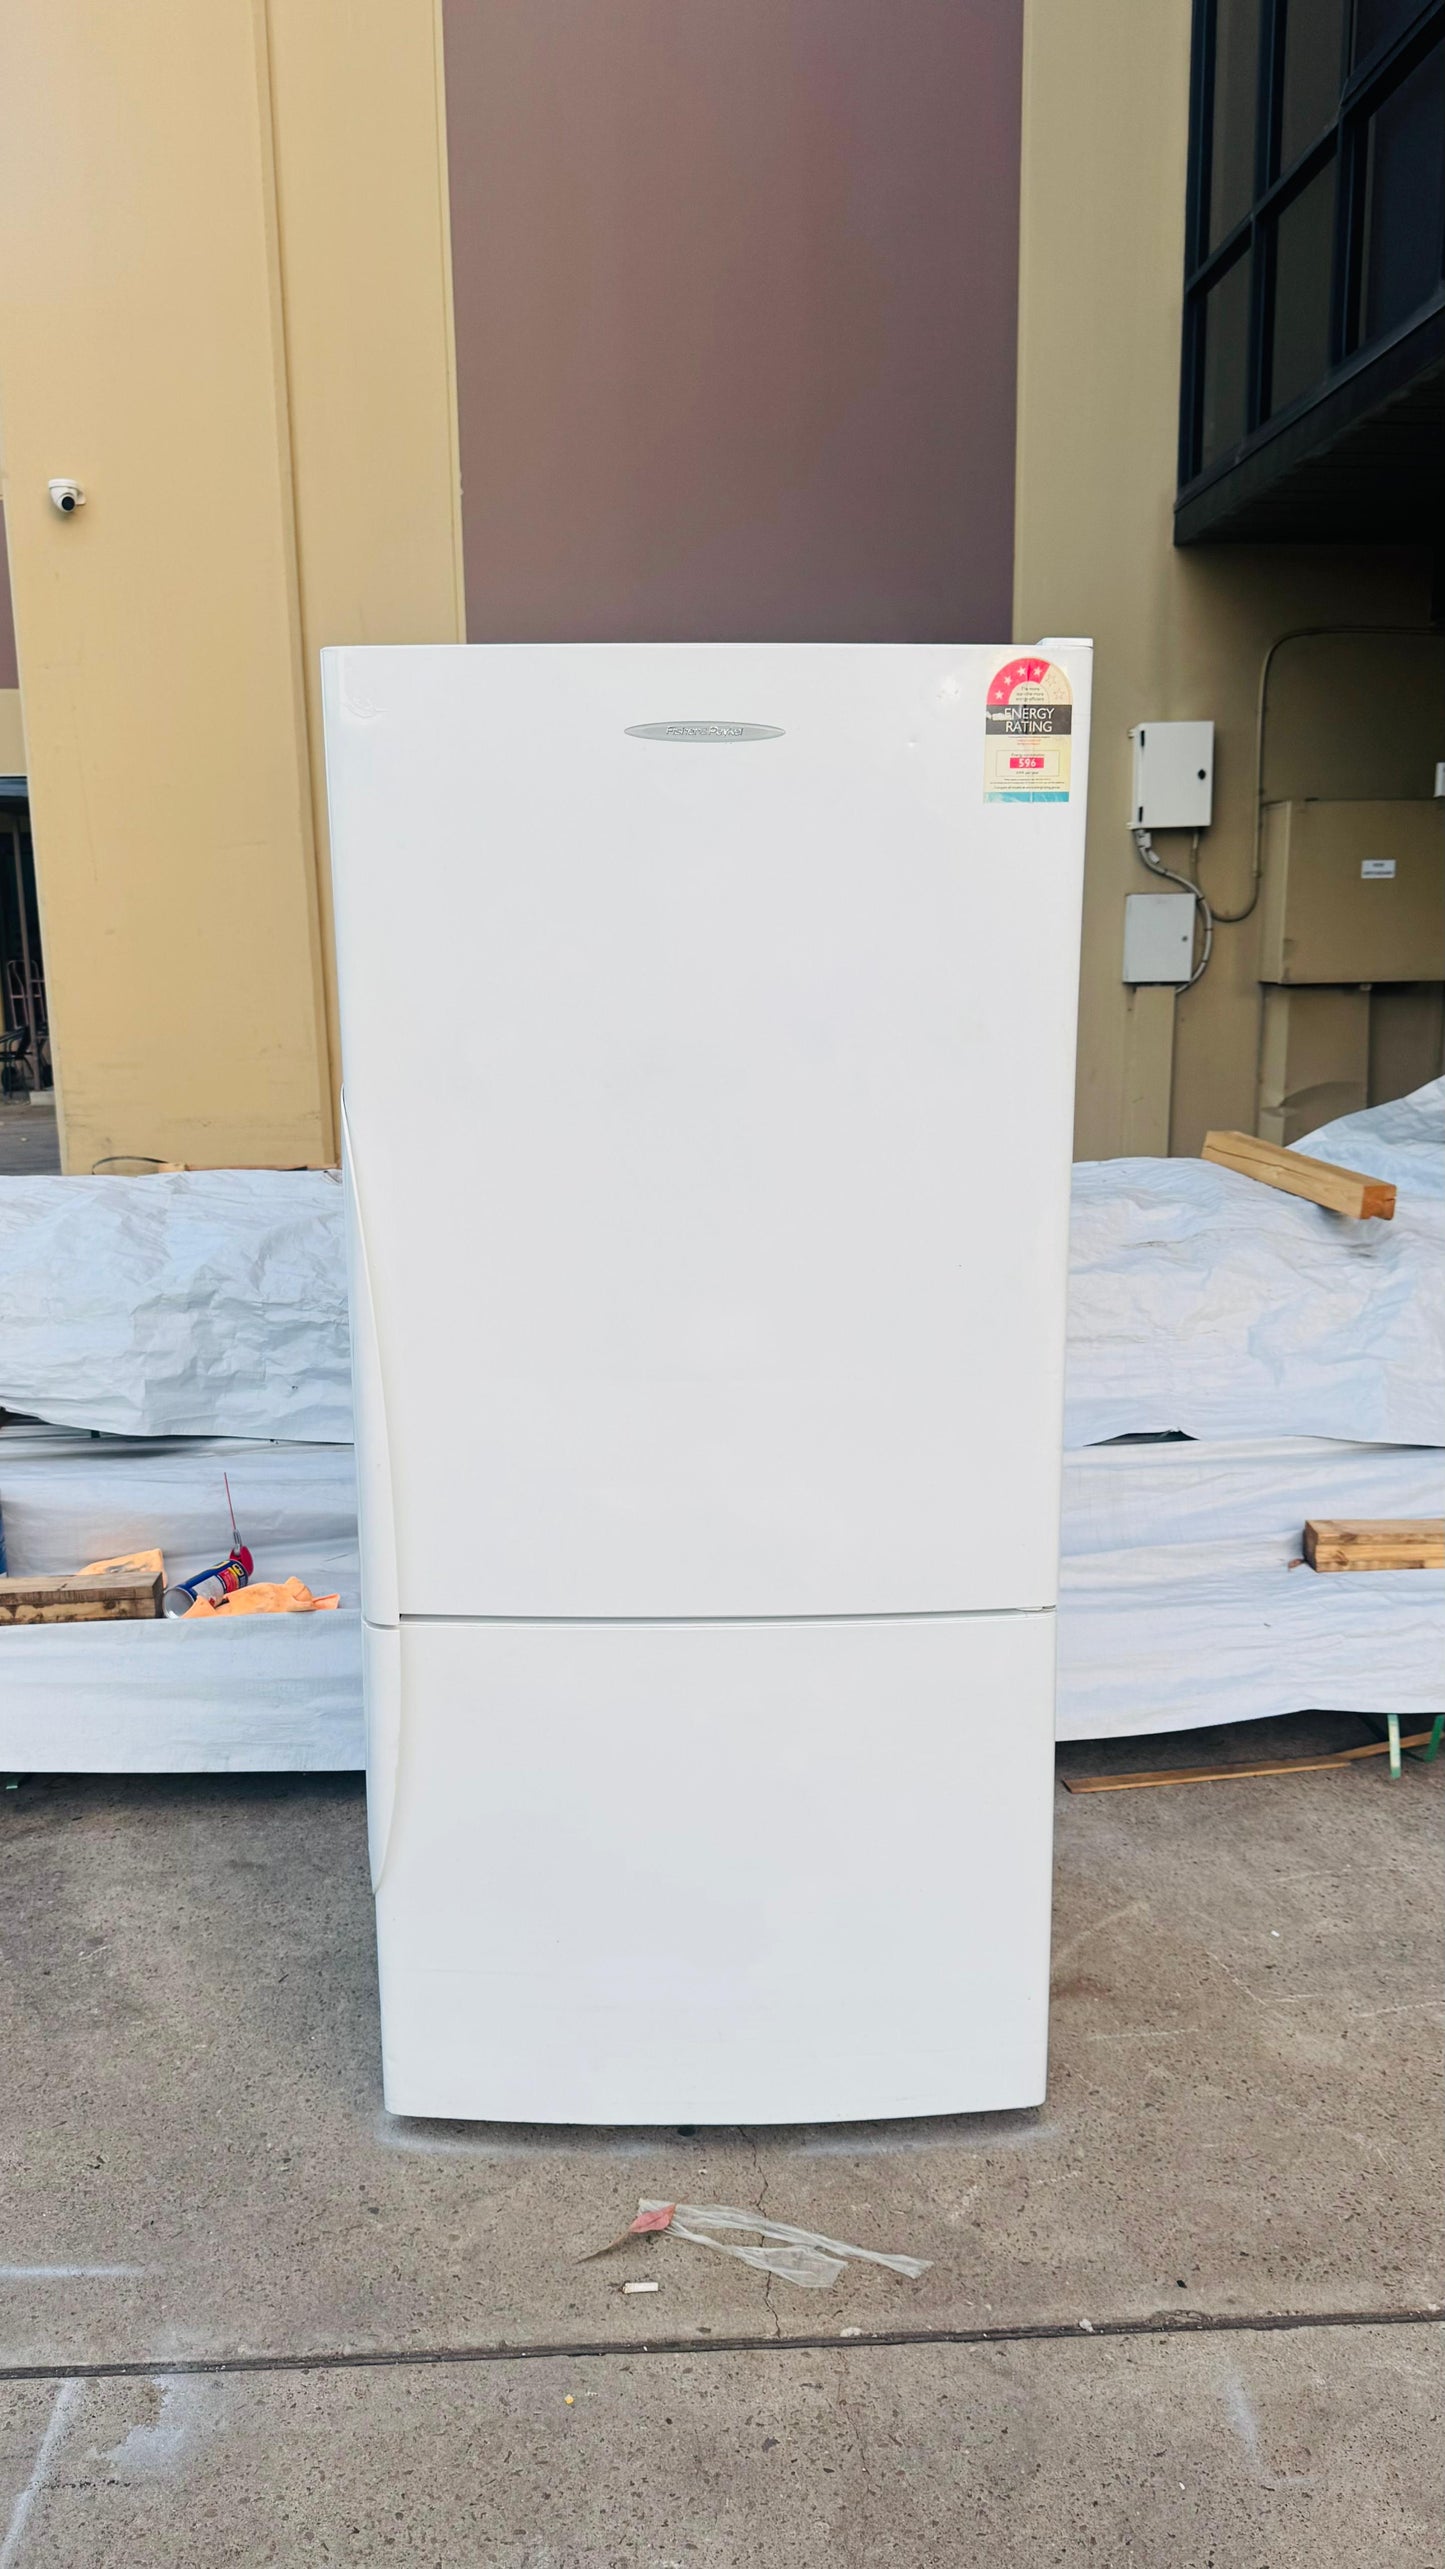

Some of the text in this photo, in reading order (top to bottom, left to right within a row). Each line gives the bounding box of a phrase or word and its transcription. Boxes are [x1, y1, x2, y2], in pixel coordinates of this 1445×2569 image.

[1004, 707, 1055, 720] ENERGY
[1005, 721, 1053, 732] RATING
[1018, 758, 1037, 768] 596
